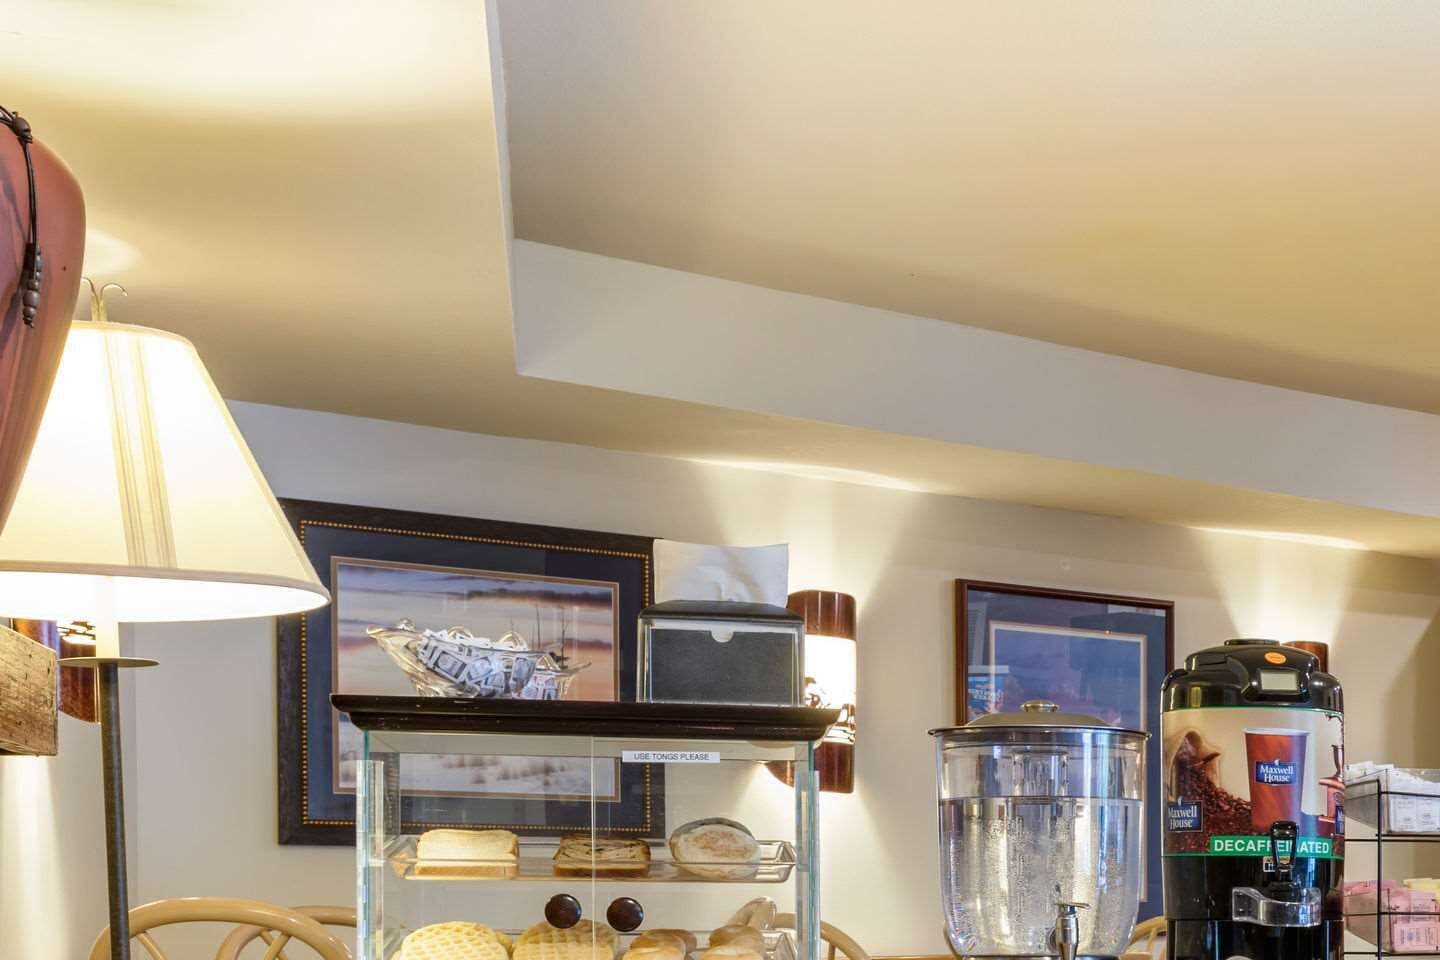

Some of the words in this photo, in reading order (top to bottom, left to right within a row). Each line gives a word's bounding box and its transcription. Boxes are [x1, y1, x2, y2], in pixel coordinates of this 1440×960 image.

[633, 752, 650, 760] USE
[652, 752, 678, 761] TONGS
[680, 752, 709, 761] PLEASE
[1260, 764, 1294, 774] Maxwell
[1264, 774, 1289, 783] House
[1168, 804, 1198, 818] Maxwell
[1170, 818, 1193, 830] House
